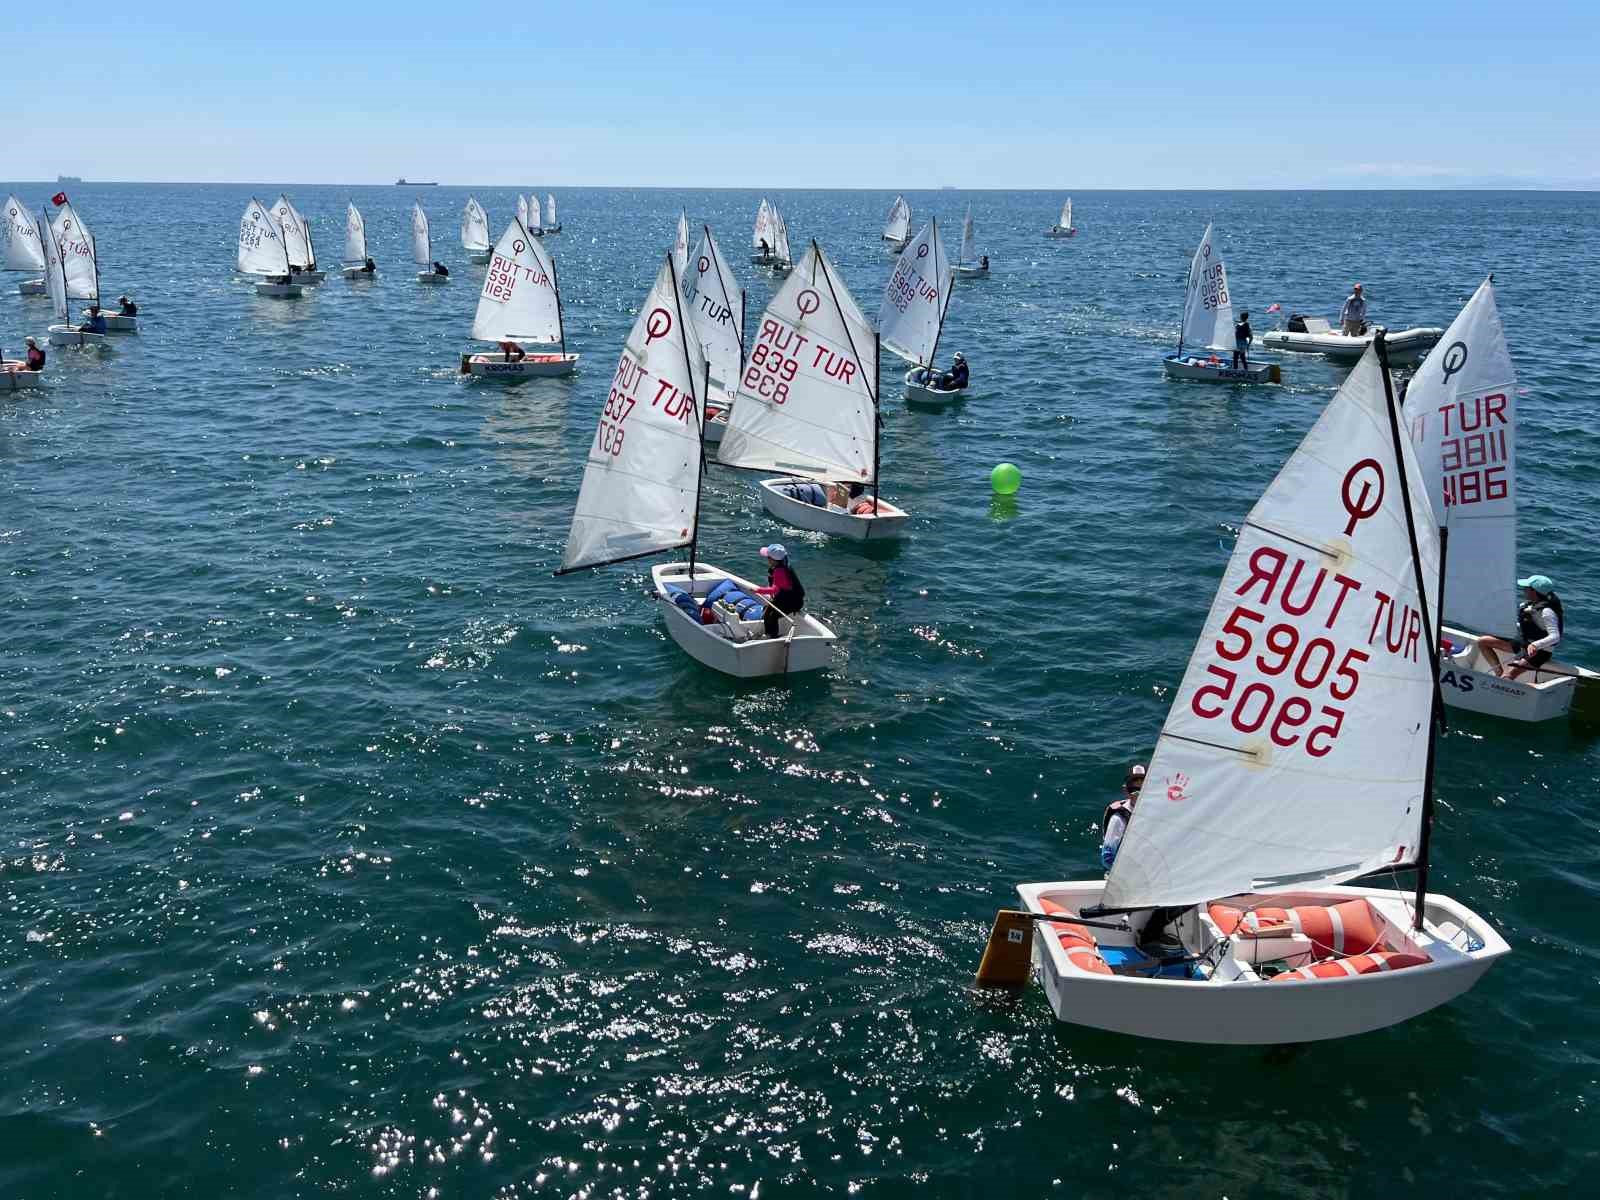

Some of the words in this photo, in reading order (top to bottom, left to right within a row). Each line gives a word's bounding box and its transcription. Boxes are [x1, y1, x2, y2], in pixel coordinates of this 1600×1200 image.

[16, 225, 34, 238] TUR
[261, 227, 277, 240] TUR
[69, 241, 90, 257] TUR
[489, 269, 516, 289] 5911
[526, 268, 548, 288] TUR
[1203, 264, 1223, 281] TUR
[916, 276, 938, 304] TUR
[1203, 291, 1228, 310] 5910
[701, 295, 731, 326] TUR
[752, 343, 798, 382] 839
[813, 344, 856, 385] TUR
[604, 387, 636, 425] 837
[652, 378, 695, 426] TUR
[1438, 393, 1508, 437] TUR
[1442, 466, 1508, 508] 1186
[1367, 590, 1421, 663] TUR
[1215, 605, 1370, 701] 5905
